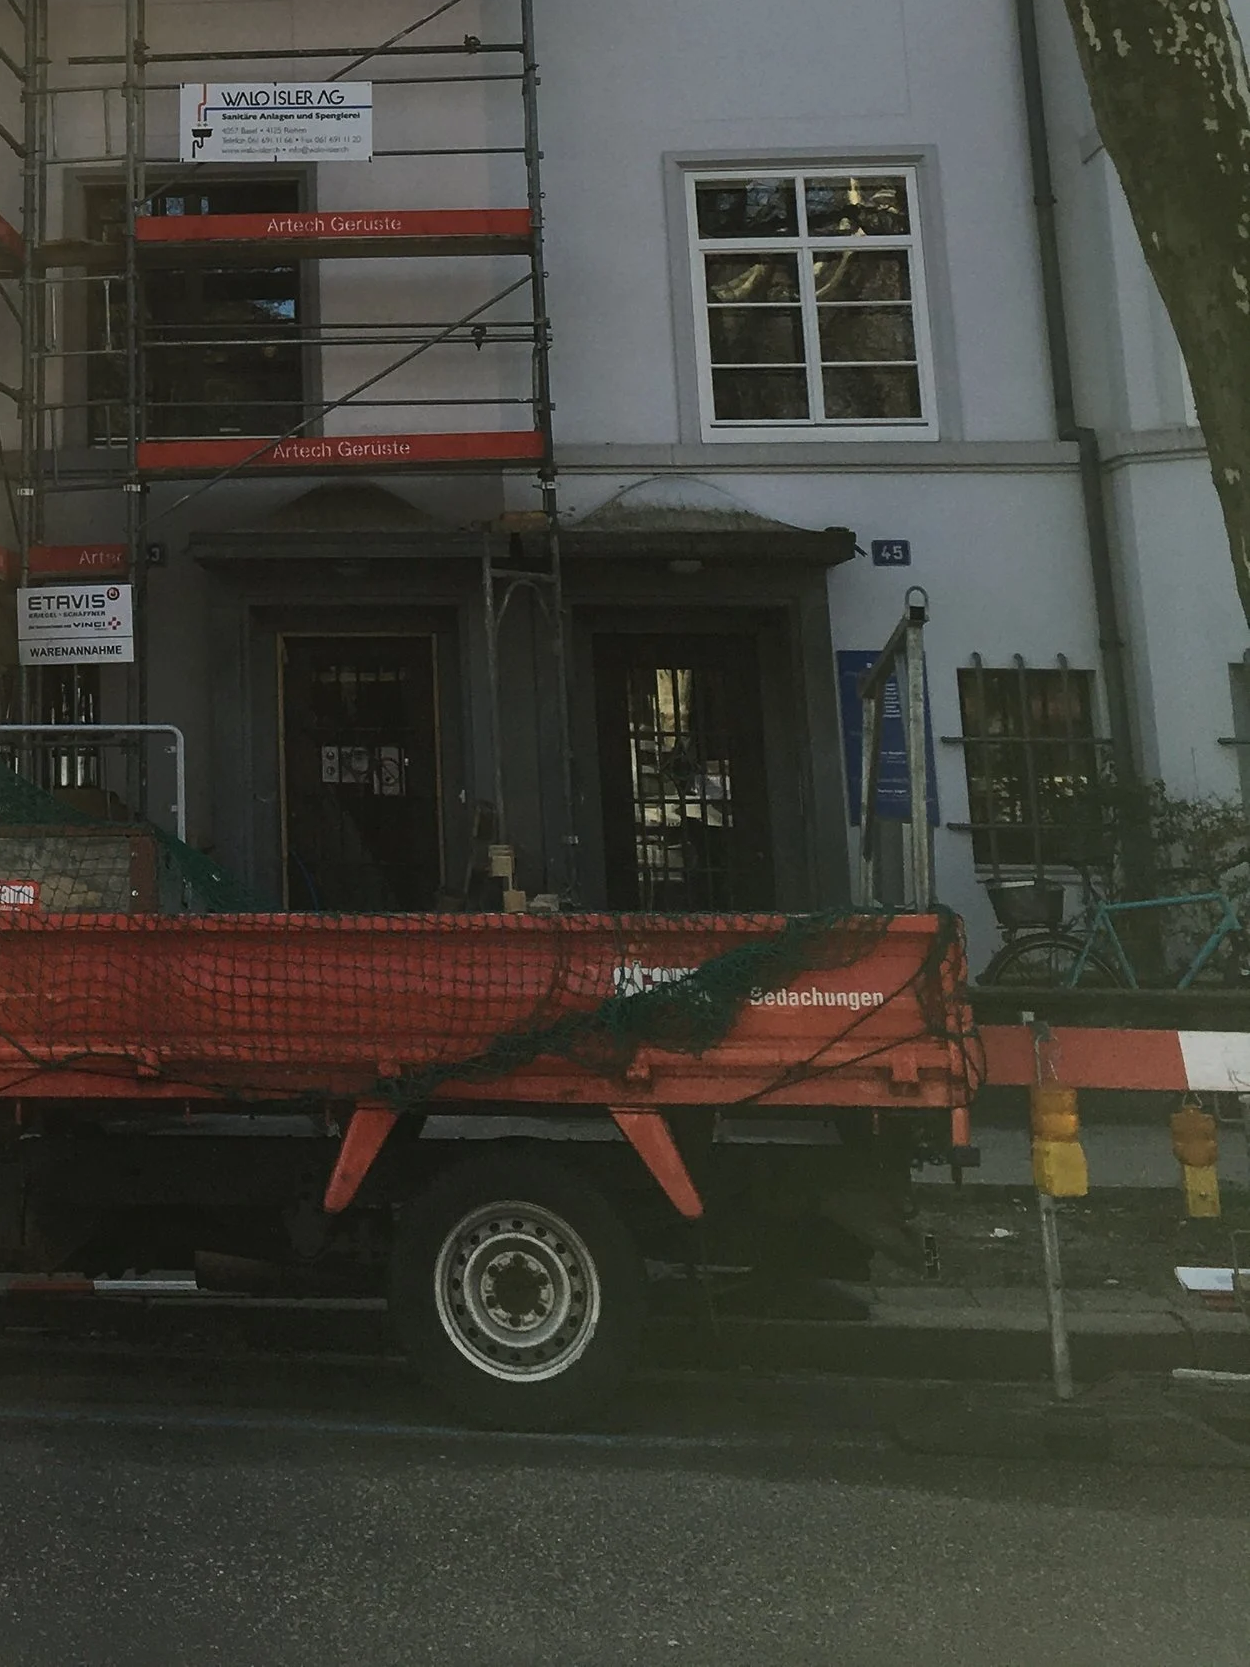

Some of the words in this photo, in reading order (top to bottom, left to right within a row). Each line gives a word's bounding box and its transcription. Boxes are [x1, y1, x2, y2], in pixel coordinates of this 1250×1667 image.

[221, 90, 270, 107] WALO
[273, 90, 313, 105] ISLER
[317, 89, 345, 105] AG
[222, 112, 258, 121] Sanitäre
[259, 112, 295, 122] Anlagen
[296, 112, 313, 120] und
[315, 111, 361, 122] Spenglerei
[267, 217, 324, 232] Artech
[273, 442, 332, 458] Artech
[338, 440, 410, 456] Gerüste
[880, 545, 903, 560] 45
[28, 594, 105, 611] ETAVIS
[30, 645, 123, 658] WARENANNAHME
